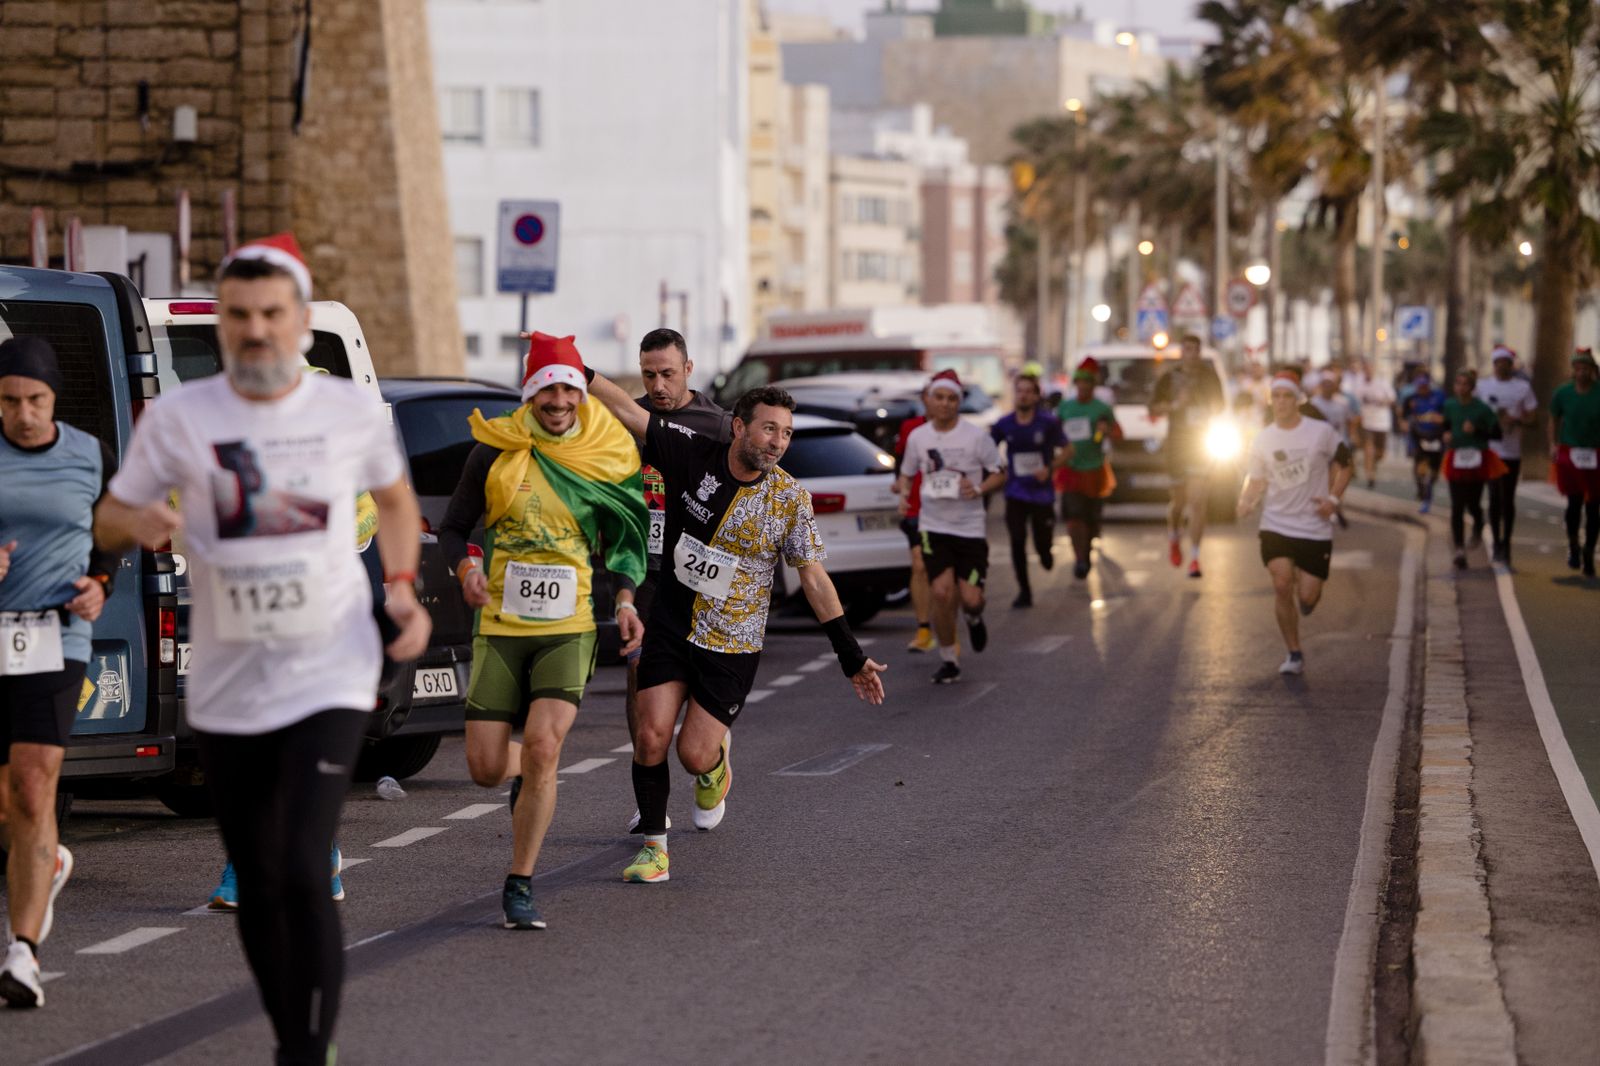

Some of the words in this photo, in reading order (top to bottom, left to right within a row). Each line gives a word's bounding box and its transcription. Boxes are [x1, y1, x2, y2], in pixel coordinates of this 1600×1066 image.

[681, 490, 714, 521] MONKEY
[686, 506, 708, 525] runners
[647, 523, 661, 538] 3
[683, 553, 720, 580] 240
[228, 579, 307, 615] 1123
[520, 579, 560, 600] 840
[13, 631, 27, 652] 6
[422, 672, 453, 693] GXD
